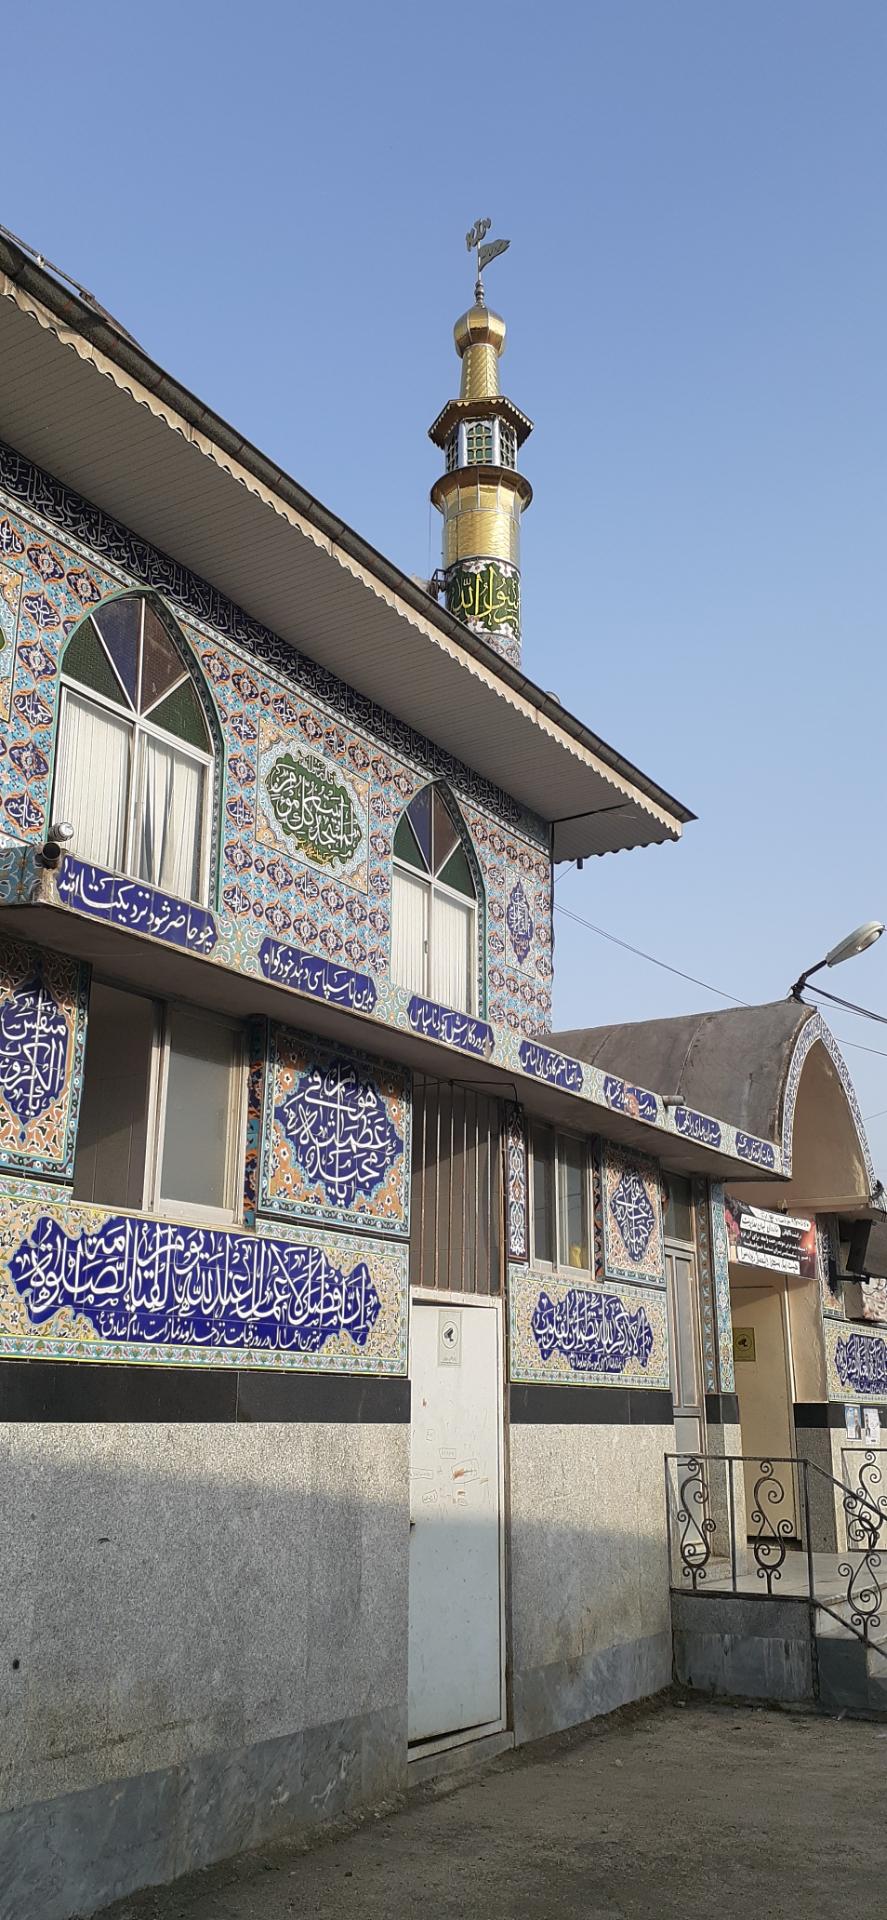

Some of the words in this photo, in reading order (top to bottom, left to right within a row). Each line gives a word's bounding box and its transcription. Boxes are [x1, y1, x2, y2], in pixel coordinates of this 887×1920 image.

[160, 905, 198, 939] حاضر
[101, 1313, 127, 1338] صادق
[126, 1314, 140, 1340] امام
[164, 1317, 182, 1342] نماز
[179, 1320, 216, 1343] خداوند
[214, 1323, 226, 1345] نزد
[224, 1323, 253, 1346] قیامت
[250, 1328, 263, 1346] روز
[270, 1325, 301, 1349] اعمال
[261, 1335, 271, 1347] در
[300, 1327, 322, 1351] بهترین
